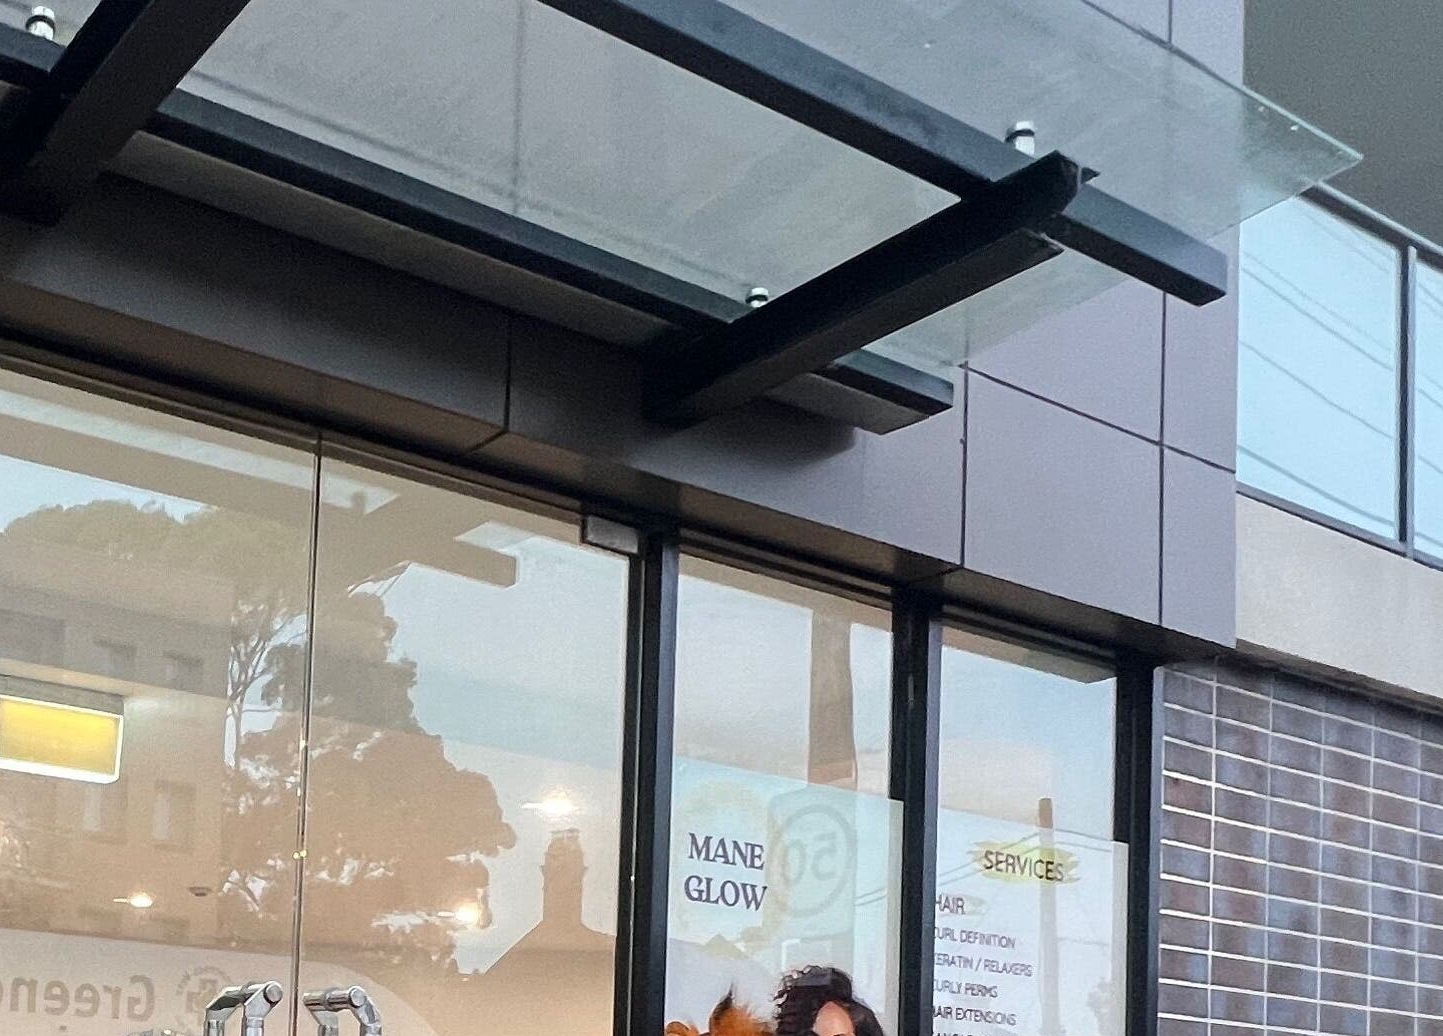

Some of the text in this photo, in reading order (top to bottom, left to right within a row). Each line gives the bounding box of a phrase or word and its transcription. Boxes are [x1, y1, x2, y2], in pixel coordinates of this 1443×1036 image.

[688, 832, 765, 870] MANE
[984, 850, 1065, 882] SERVICES
[684, 875, 767, 911] GLOW
[960, 930, 1016, 949] DEFINITION
[934, 953, 973, 970] ERATIN
[984, 959, 1033, 977] RELAXERS
[965, 983, 998, 998] PERMS
[956, 1007, 1017, 1026] EXTENSIONS
